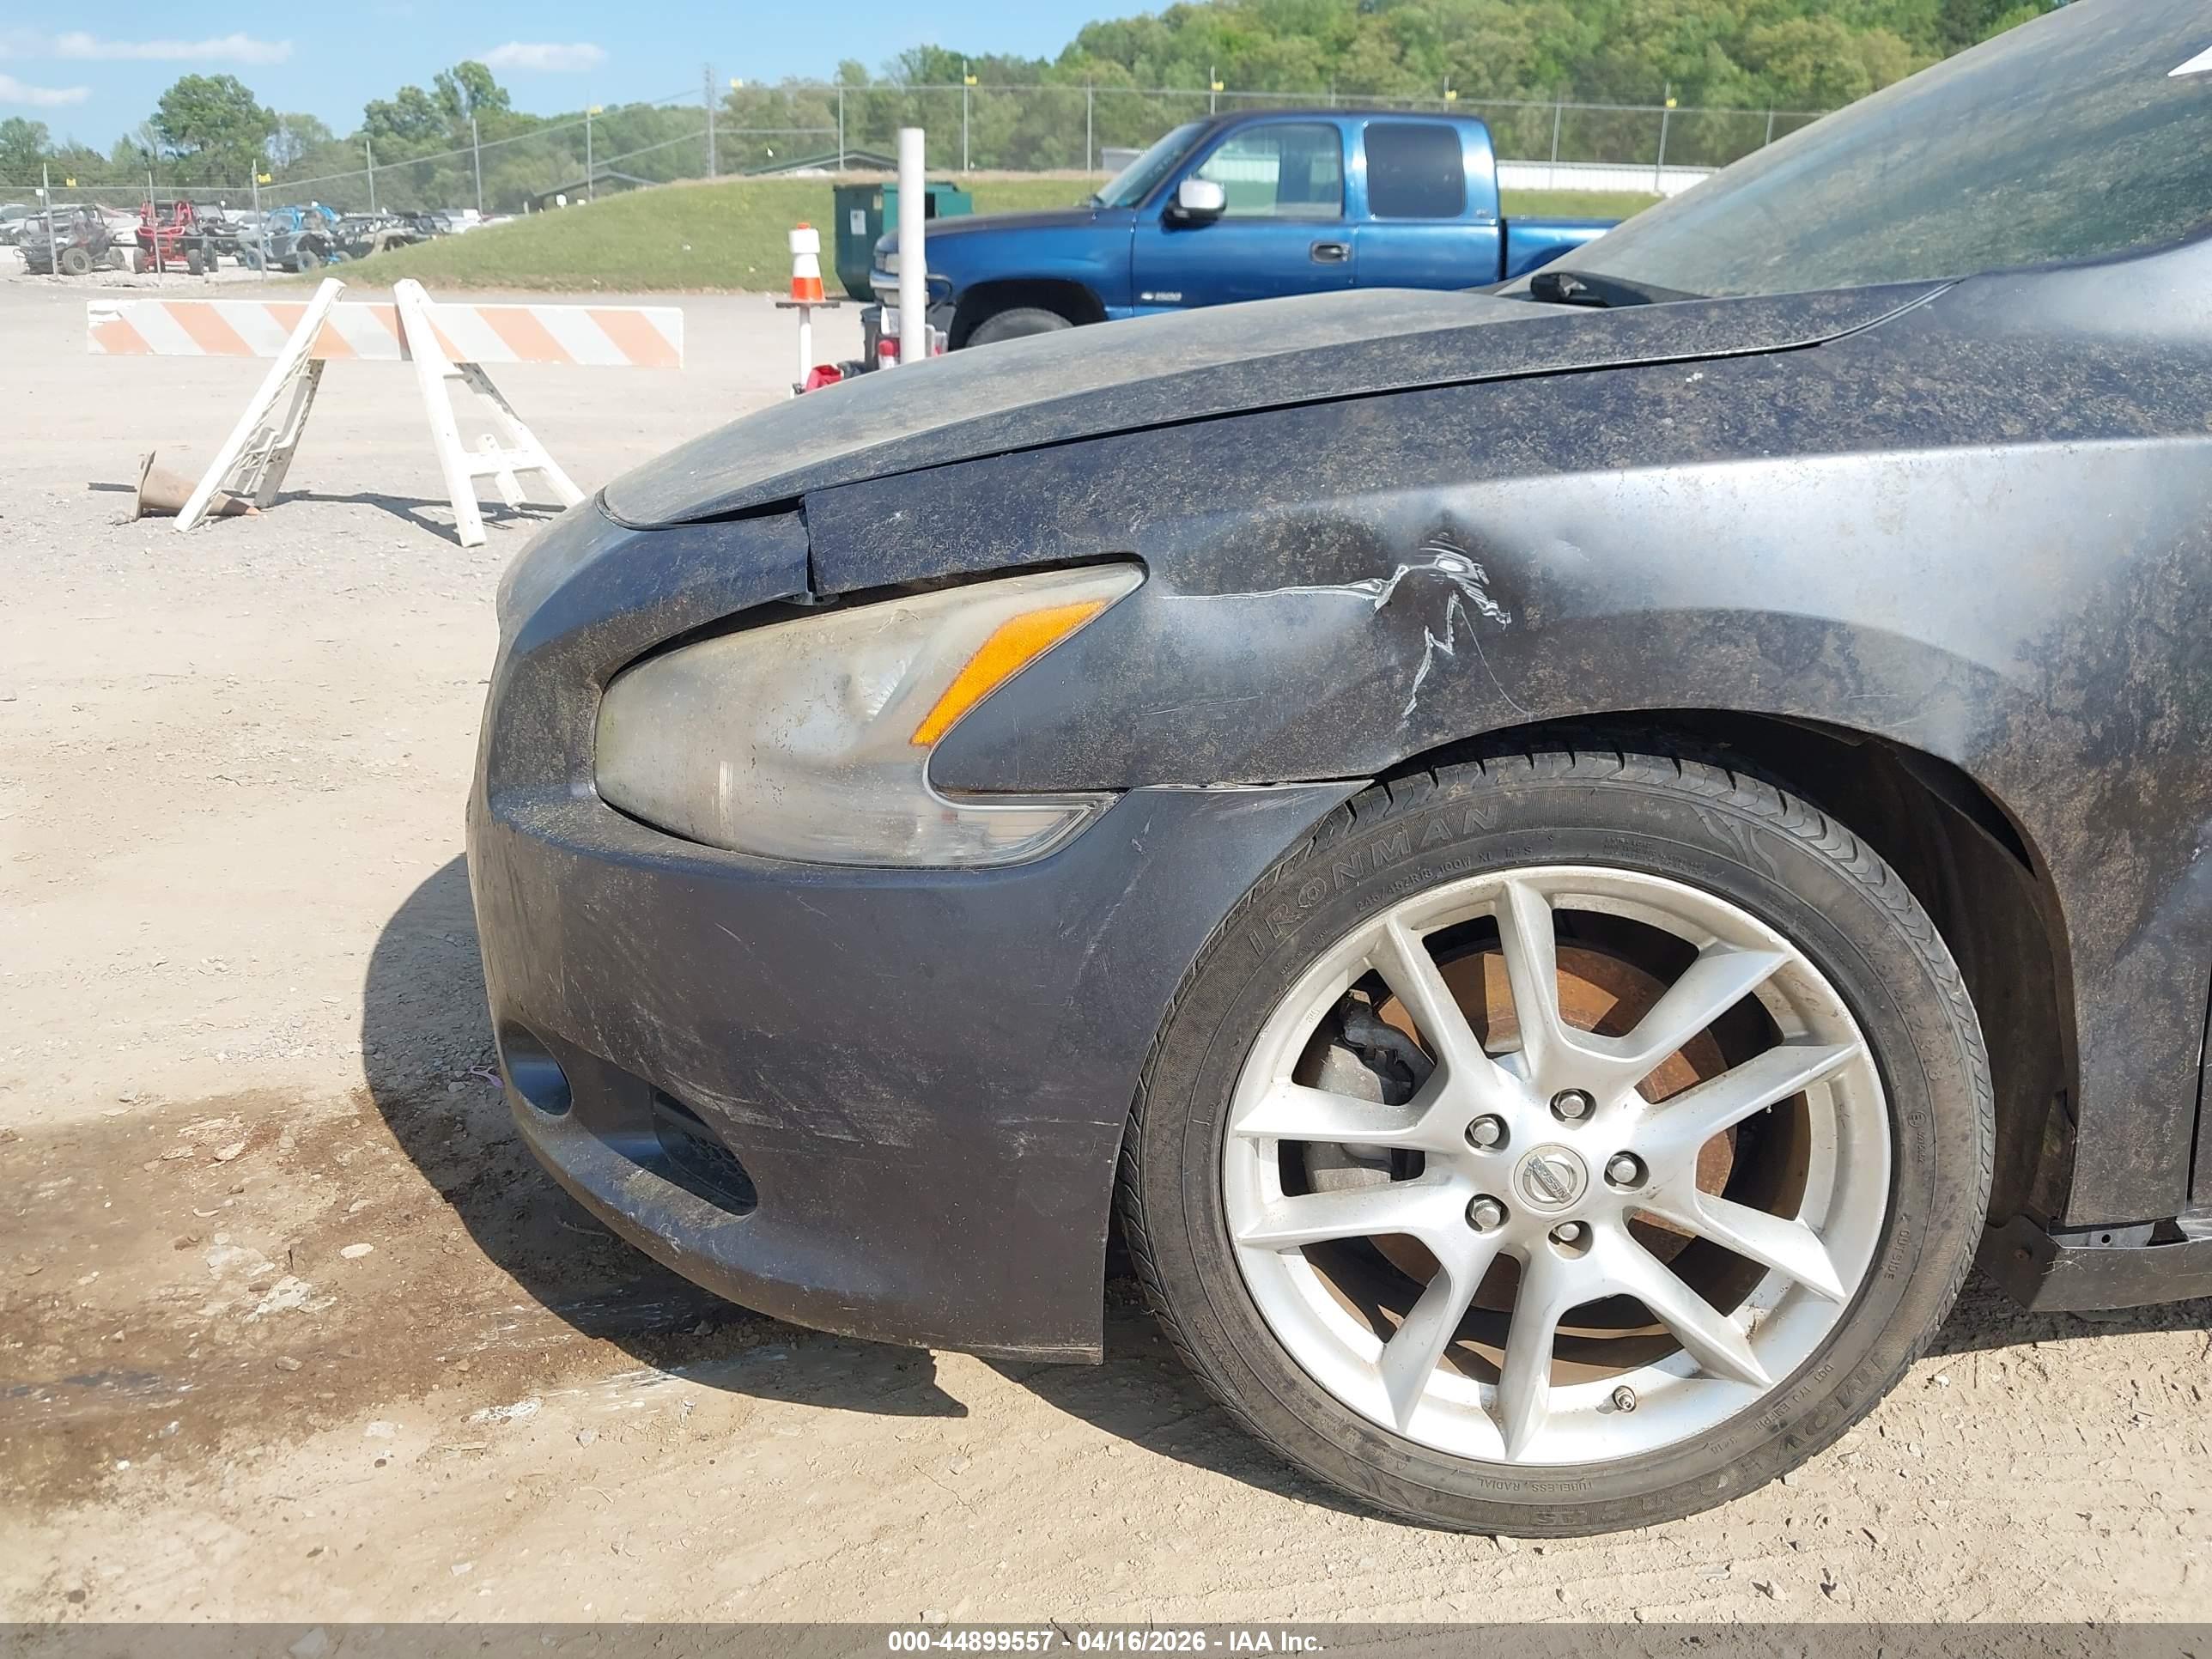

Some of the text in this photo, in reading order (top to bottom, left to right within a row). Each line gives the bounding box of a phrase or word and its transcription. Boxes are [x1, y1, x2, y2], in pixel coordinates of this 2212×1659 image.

[1247, 804, 1500, 956] IRONMAN
[1883, 1230, 1911, 1280] OUTSIDE
[1811, 1363, 1836, 1384] DOT
[1474, 1476, 1592, 1492] TUBELESS RADIAL
